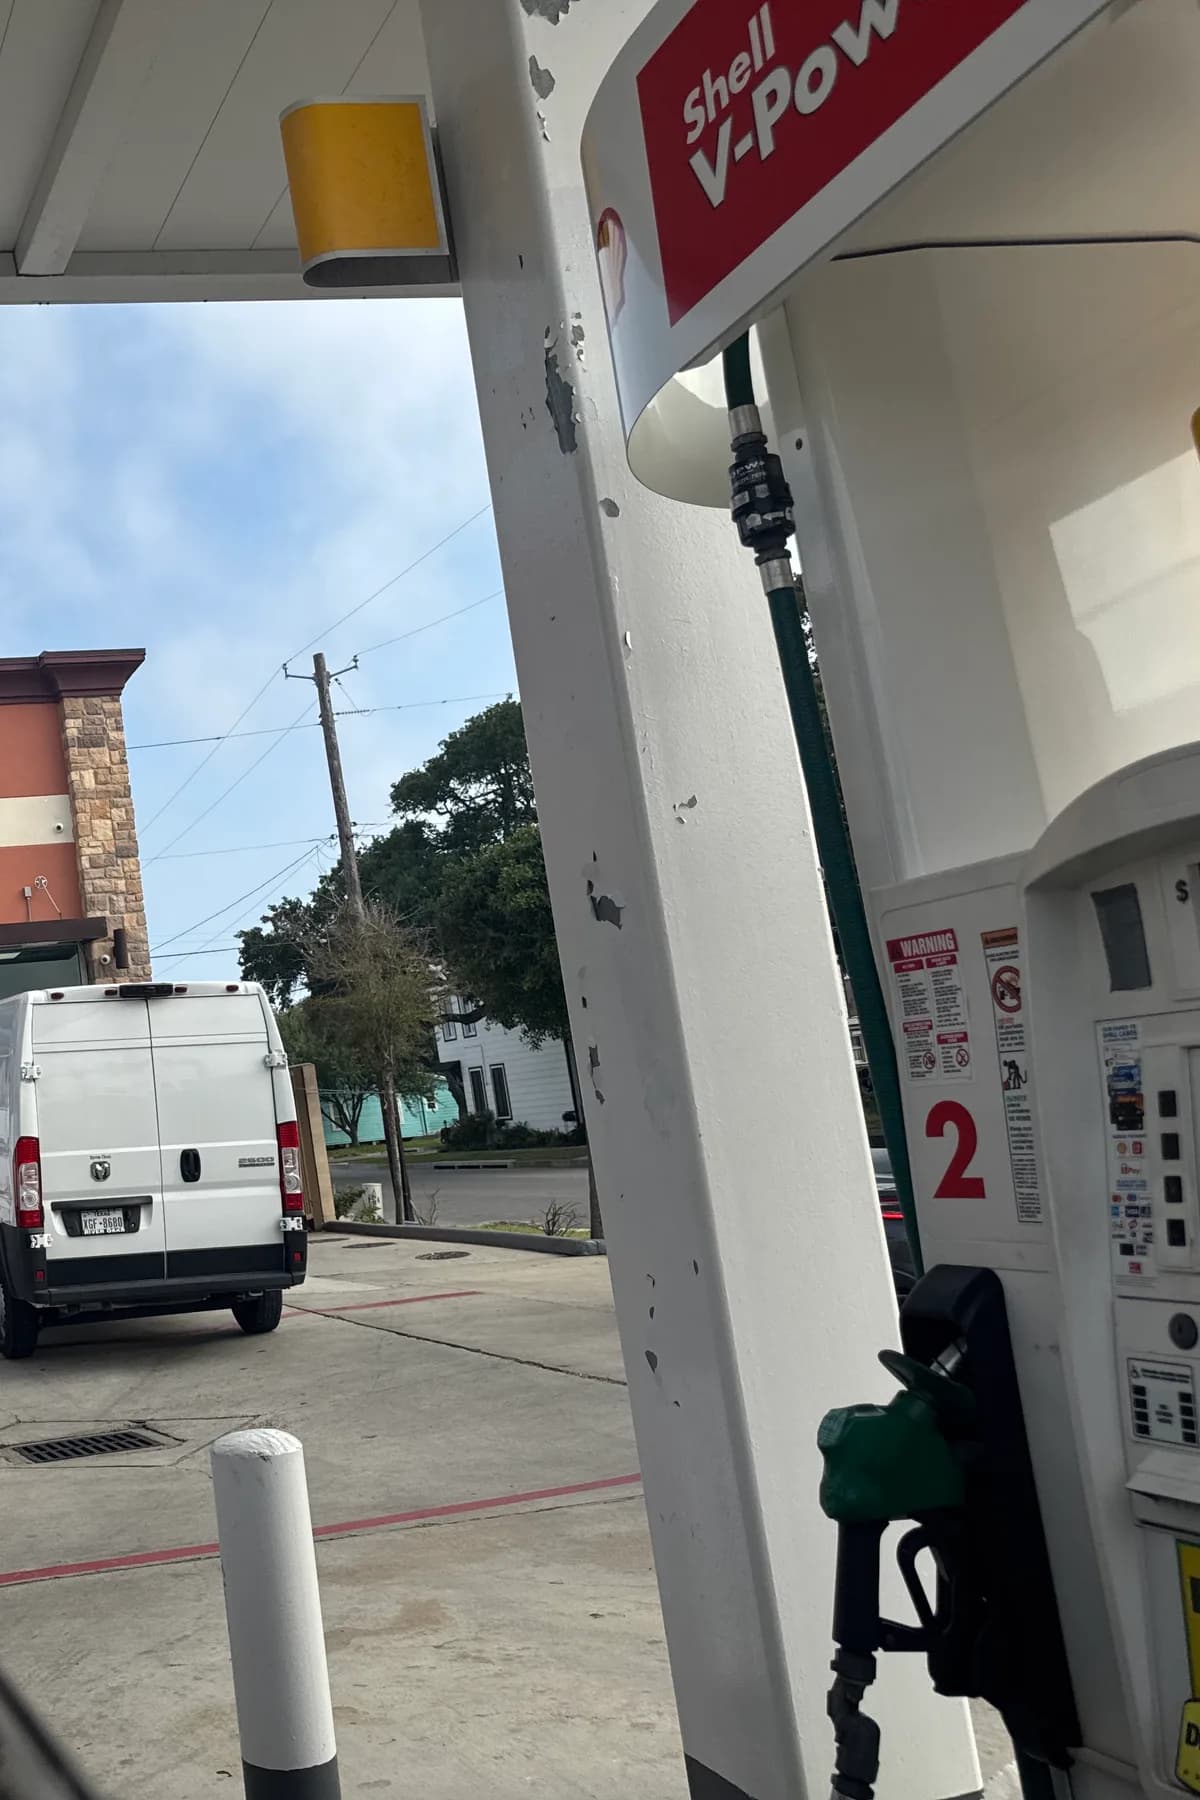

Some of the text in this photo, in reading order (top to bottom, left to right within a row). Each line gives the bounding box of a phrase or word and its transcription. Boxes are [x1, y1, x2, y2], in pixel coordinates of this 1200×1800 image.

[683, 1, 776, 145] Shell
[900, 932, 956, 958] WARNING
[925, 1100, 986, 1199] 2
